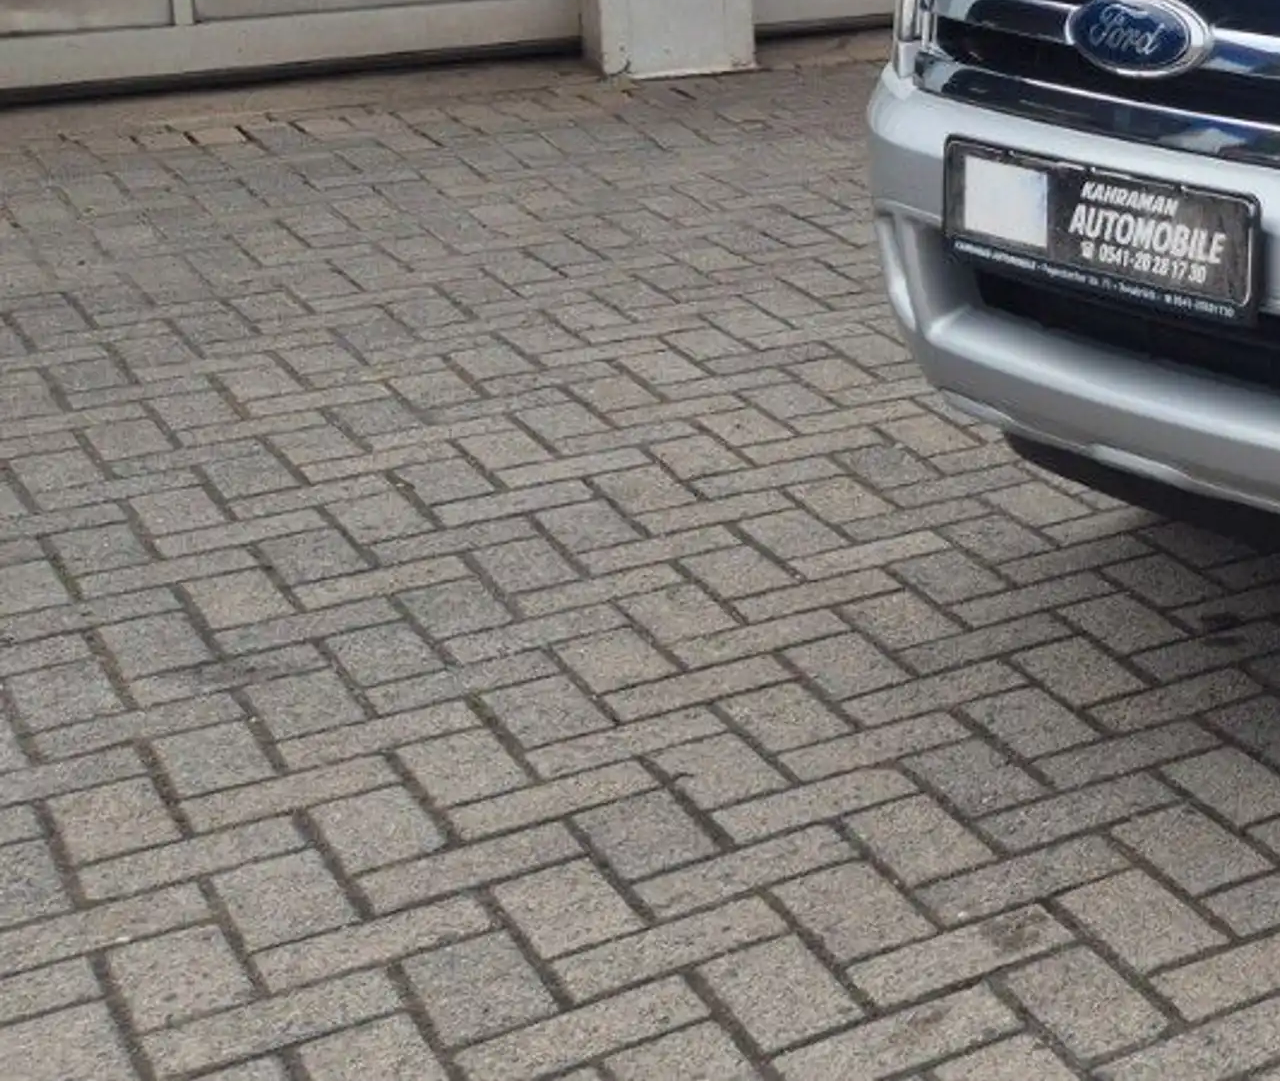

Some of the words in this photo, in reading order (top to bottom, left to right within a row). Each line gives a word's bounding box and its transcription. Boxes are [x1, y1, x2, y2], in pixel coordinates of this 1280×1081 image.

[1090, 3, 1162, 56] Ford
[1080, 181, 1179, 217] KAHRAMAN
[1067, 204, 1228, 265] AUTOMOBILE
